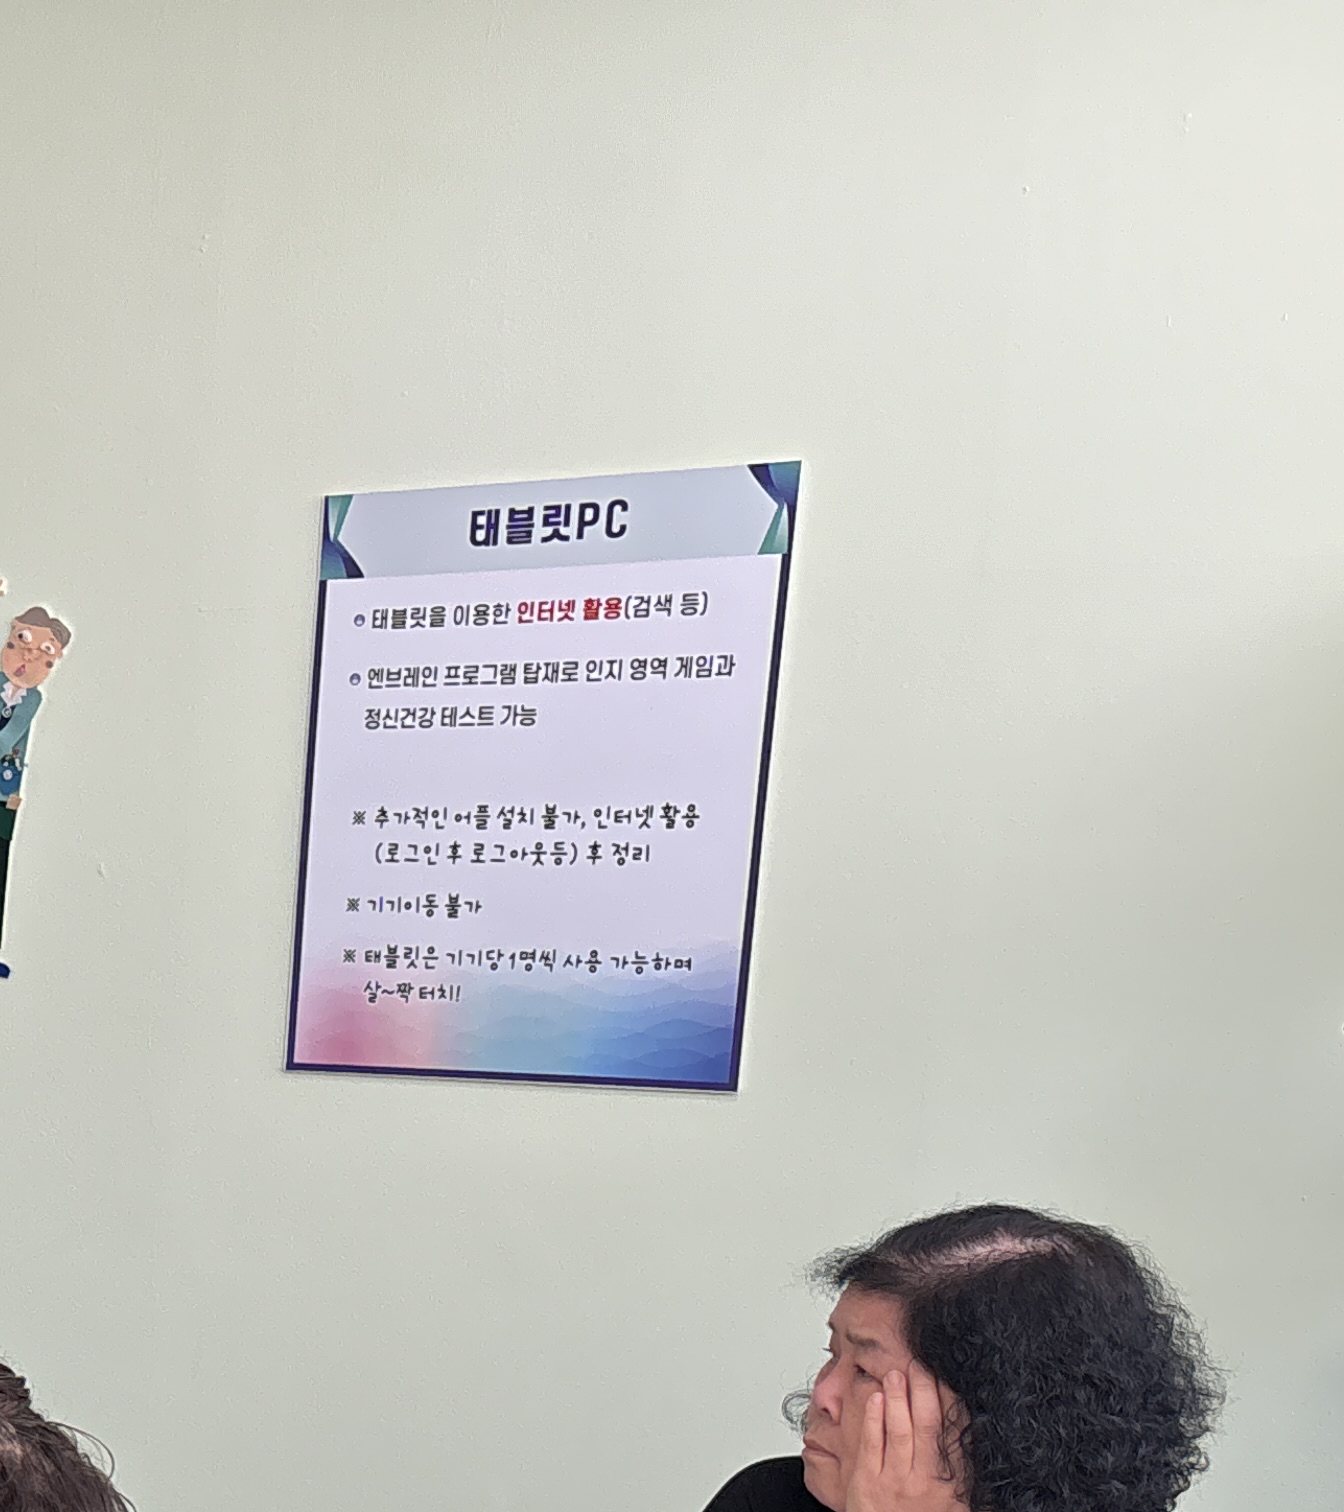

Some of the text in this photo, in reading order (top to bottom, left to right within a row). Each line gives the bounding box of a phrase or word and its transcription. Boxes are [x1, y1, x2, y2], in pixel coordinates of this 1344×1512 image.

[469, 499, 631, 548] 태블릿PC
[370, 591, 708, 630] 태블릿을 이용한 인터넷 활용(검색 등)
[367, 654, 736, 691] 엔브레인 프로그램 탑재로 인지 영역 게임과
[364, 704, 537, 730] 정신건강 테스트 가능
[374, 807, 448, 830] 추가적인
[453, 804, 491, 830] 어플
[496, 806, 536, 830] 설치
[593, 805, 655, 830] 인터넷
[659, 802, 701, 829] 활용
[375, 840, 651, 867] (로그인 후 로그아웃등) 후 정리
[367, 894, 439, 919] 기기이동
[445, 892, 483, 919] 불가
[364, 944, 440, 970] 태블릿은
[445, 949, 504, 971] 기기당
[509, 951, 558, 973] 1명씩
[563, 951, 603, 973] 사용
[610, 951, 693, 975] 가능하며
[418, 984, 461, 1004] 터치!
